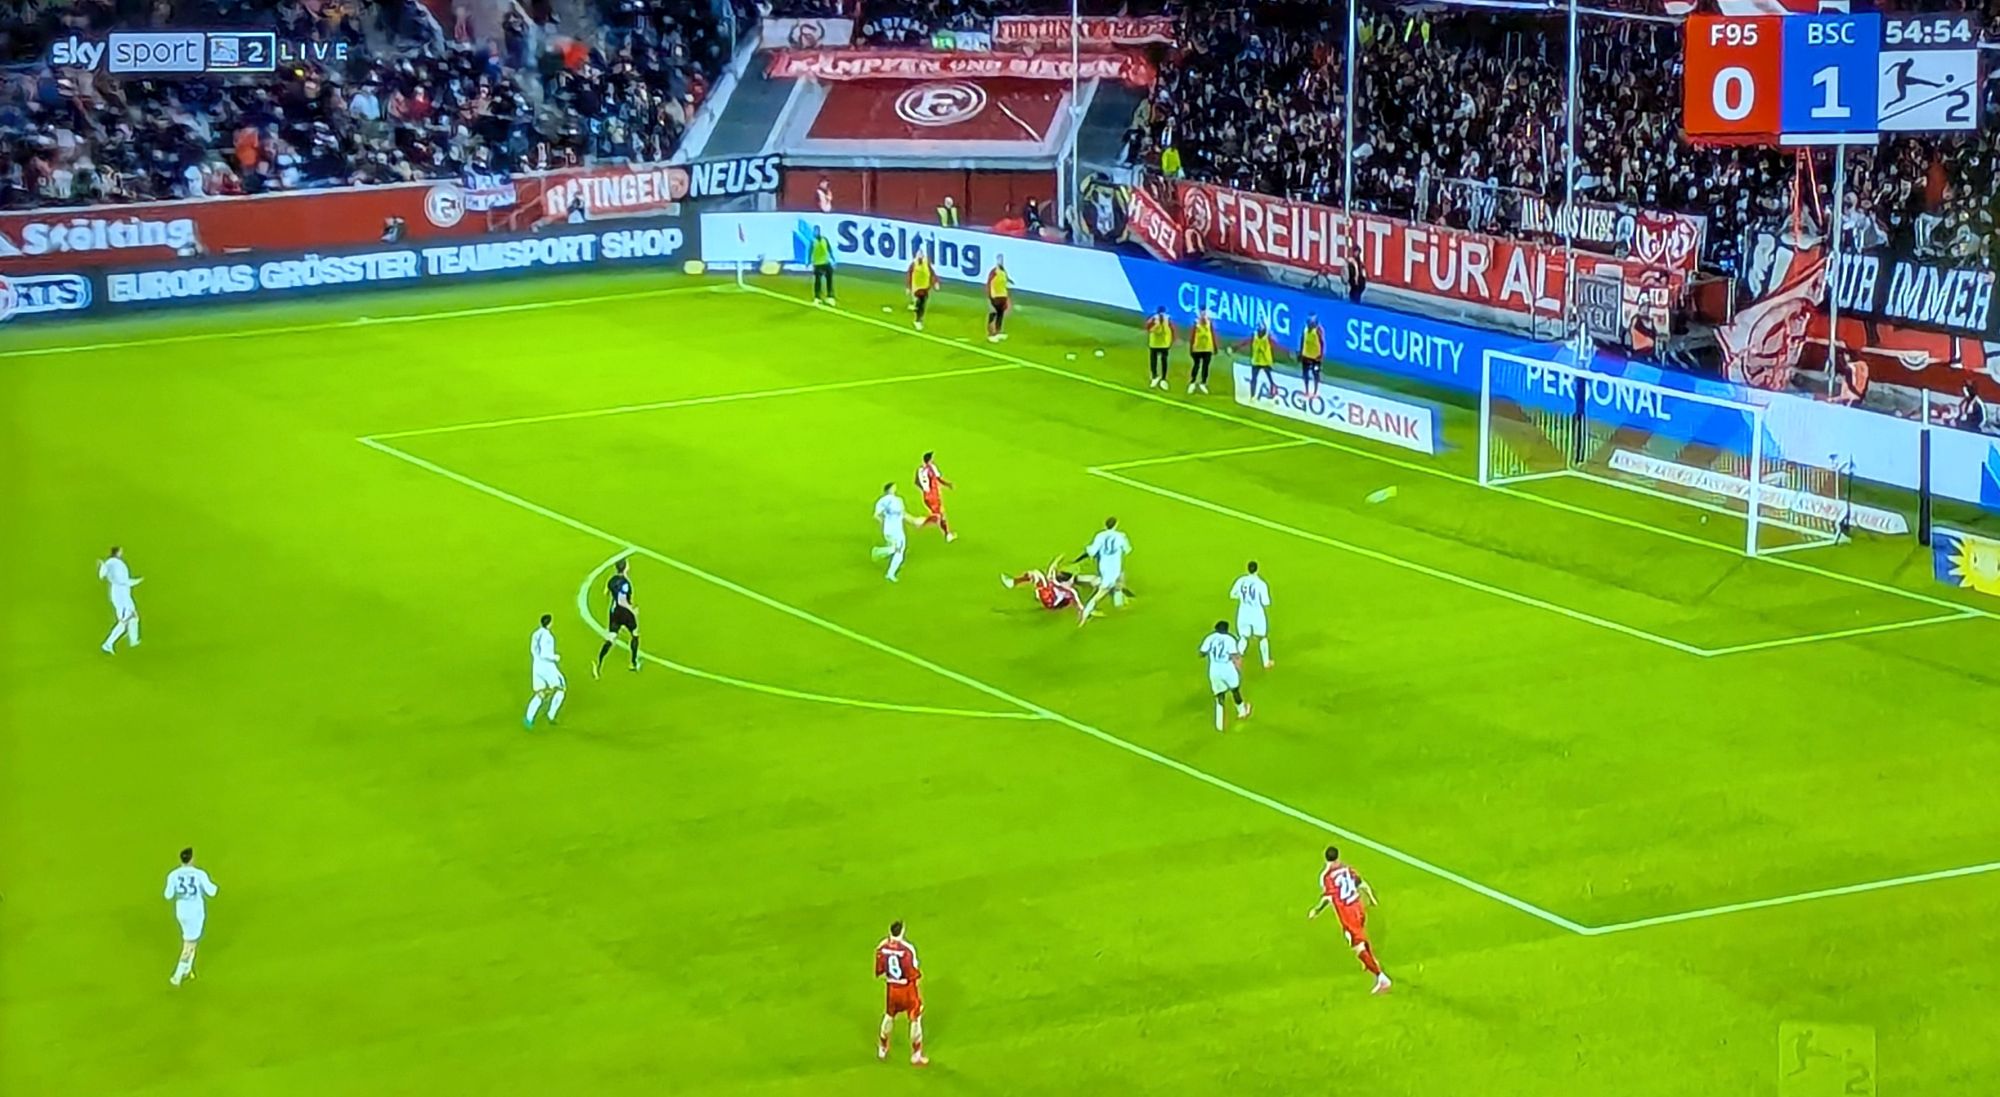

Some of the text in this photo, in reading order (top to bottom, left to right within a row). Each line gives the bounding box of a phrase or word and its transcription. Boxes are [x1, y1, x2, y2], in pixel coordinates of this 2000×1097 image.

[546, 169, 671, 216] RATINGEN
[690, 155, 780, 198] NEUSS
[22, 216, 194, 254] Stölting
[836, 219, 983, 278] Stölting
[1214, 193, 1392, 278] FREIHEIT
[1403, 224, 1490, 299] FÜR
[106, 228, 684, 304] EUROPAS GRÖSSTER TEAMSPORT SHOP
[1177, 280, 1292, 337] CLEANING
[1884, 261, 1995, 332] IMMER
[1346, 318, 1465, 376] SECURITY
[1525, 362, 1672, 421] PERSONAL
[176, 875, 198, 897] 33
